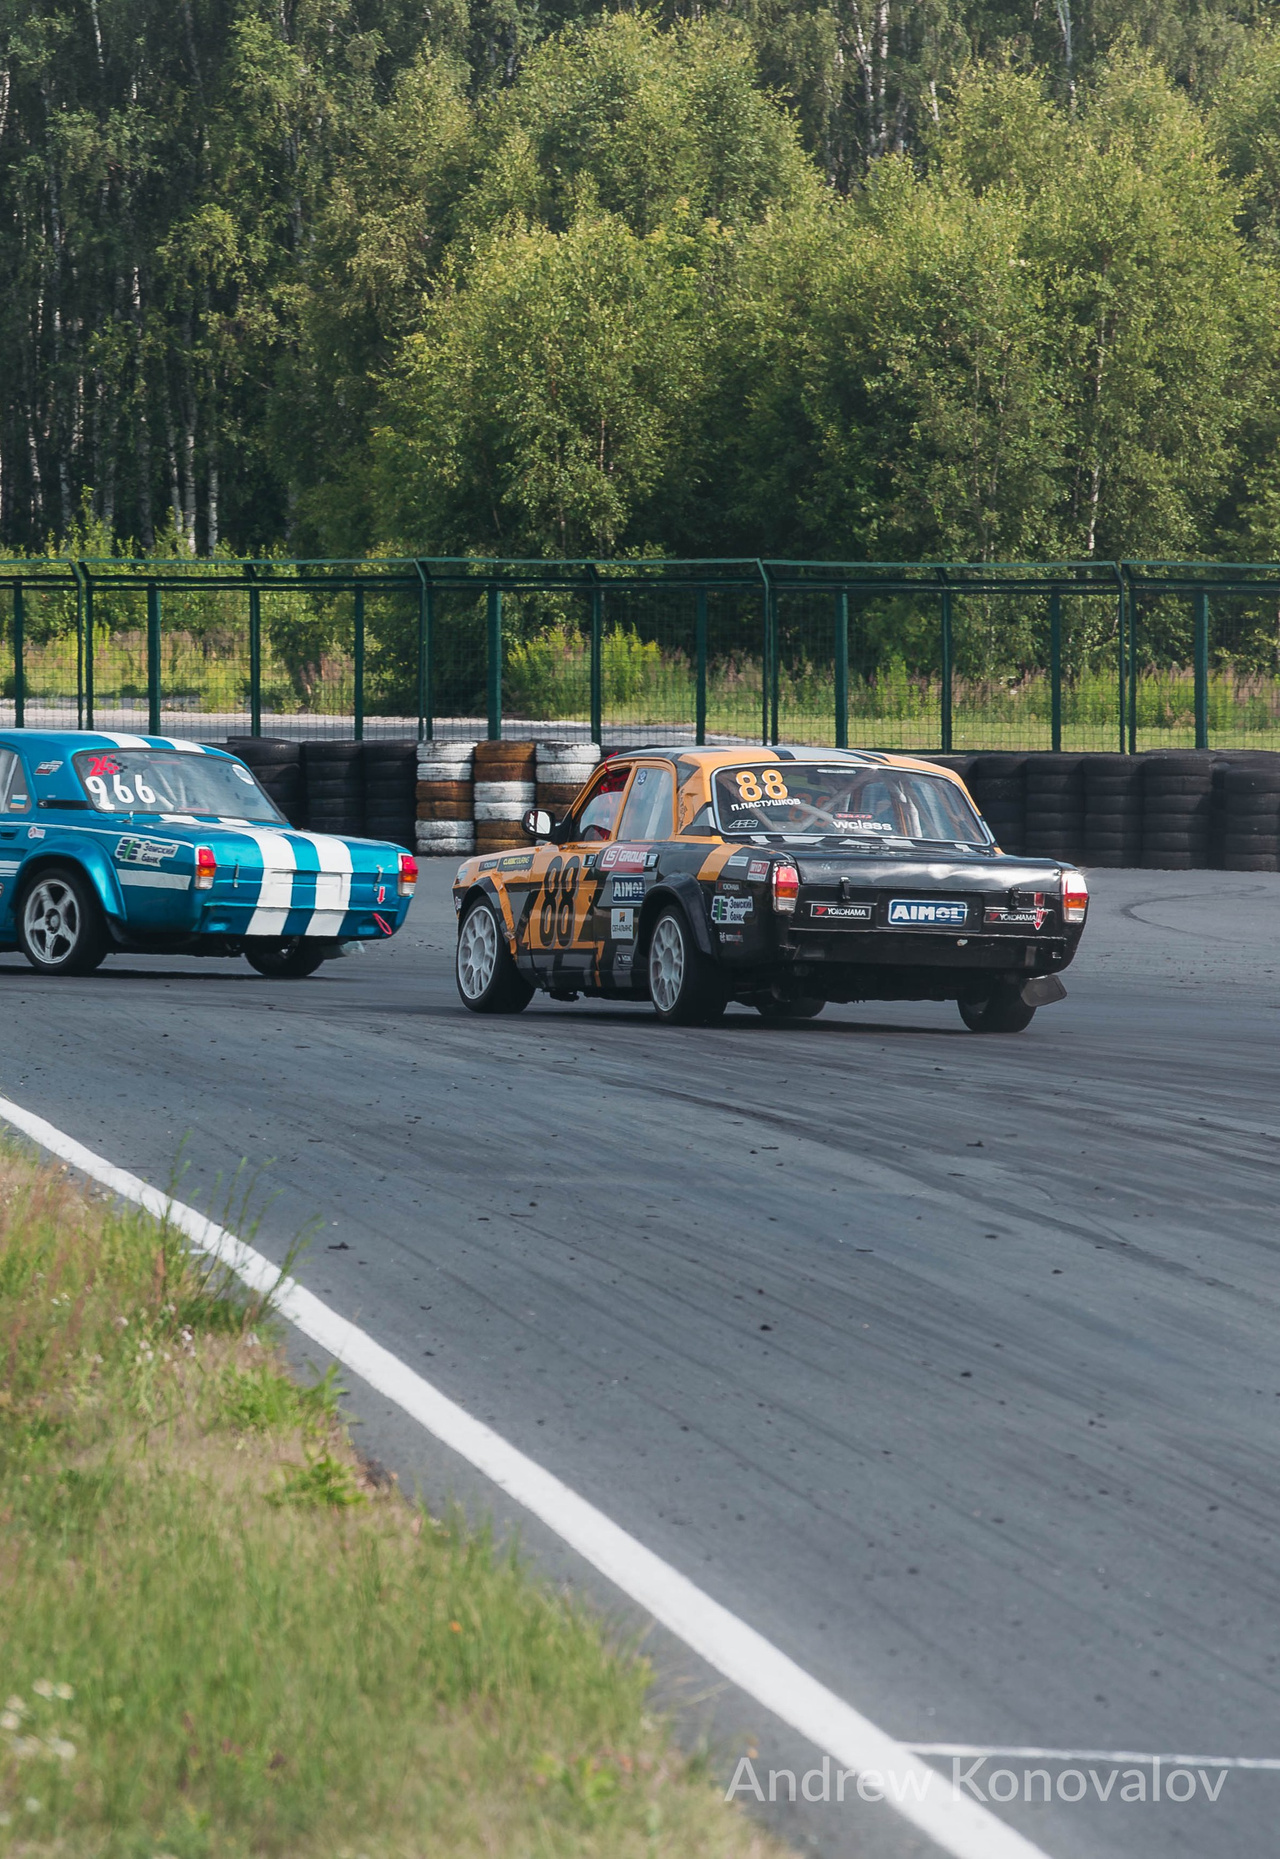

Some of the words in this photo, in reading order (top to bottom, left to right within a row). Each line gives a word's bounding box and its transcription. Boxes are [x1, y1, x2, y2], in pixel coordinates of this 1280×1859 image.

[736, 769, 788, 801] 88
[85, 775, 156, 810] 966
[730, 799, 801, 811] П.ПАСТУШКОВ
[833, 820, 892, 831] wclass
[618, 850, 647, 863] GROUP
[613, 881, 645, 898] AIMOL
[539, 855, 581, 949] 88
[729, 898, 752, 909] Земский
[730, 911, 743, 921] банк
[827, 908, 867, 916] YOKOHAMA
[891, 904, 963, 922] AIMOL
